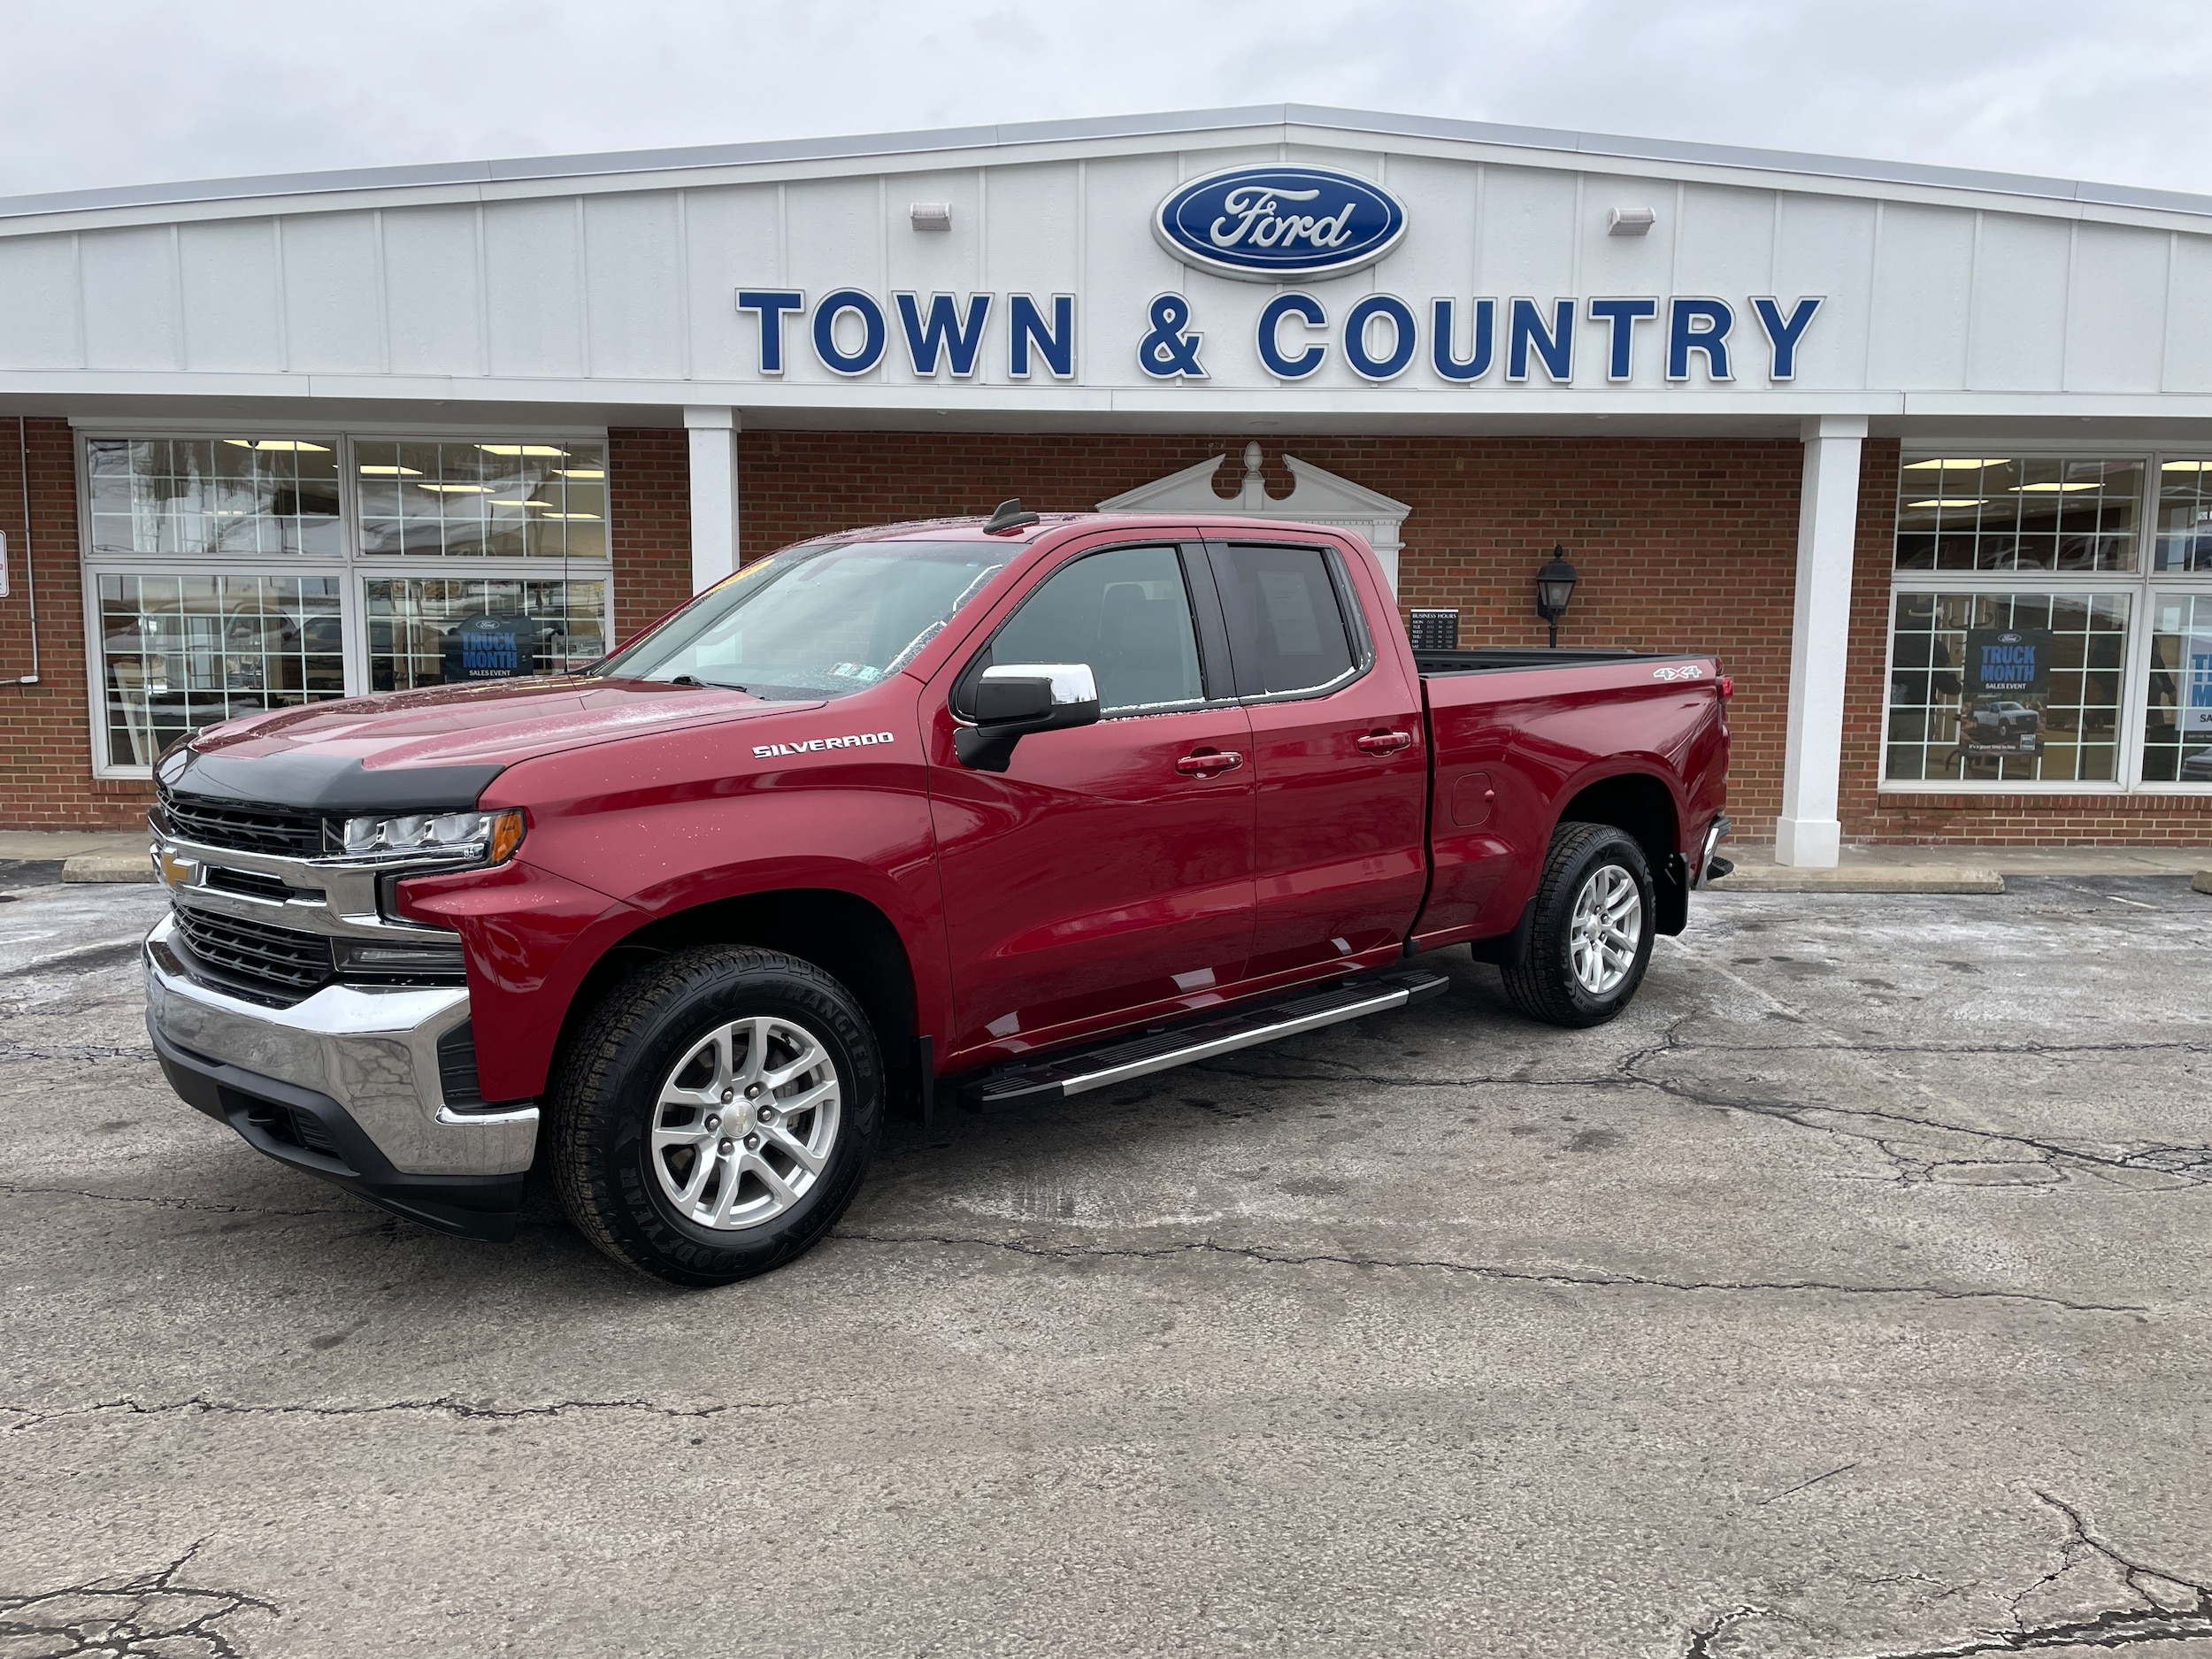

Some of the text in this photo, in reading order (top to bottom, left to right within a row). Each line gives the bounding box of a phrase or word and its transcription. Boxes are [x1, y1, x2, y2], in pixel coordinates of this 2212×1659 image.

[1210, 186, 1356, 248] Ford
[735, 288, 1826, 383] TOWN & COUNTRY
[460, 632, 517, 650] TRUCK
[1981, 645, 2035, 664] TRUCK
[462, 650, 518, 668] MONTH
[1980, 664, 2035, 681] MONTH
[2192, 654, 2212, 682] T
[752, 732, 895, 759] SILVERADO
[764, 979, 872, 1078] WRANGLER
[618, 1167, 750, 1271] GOODYEAR
